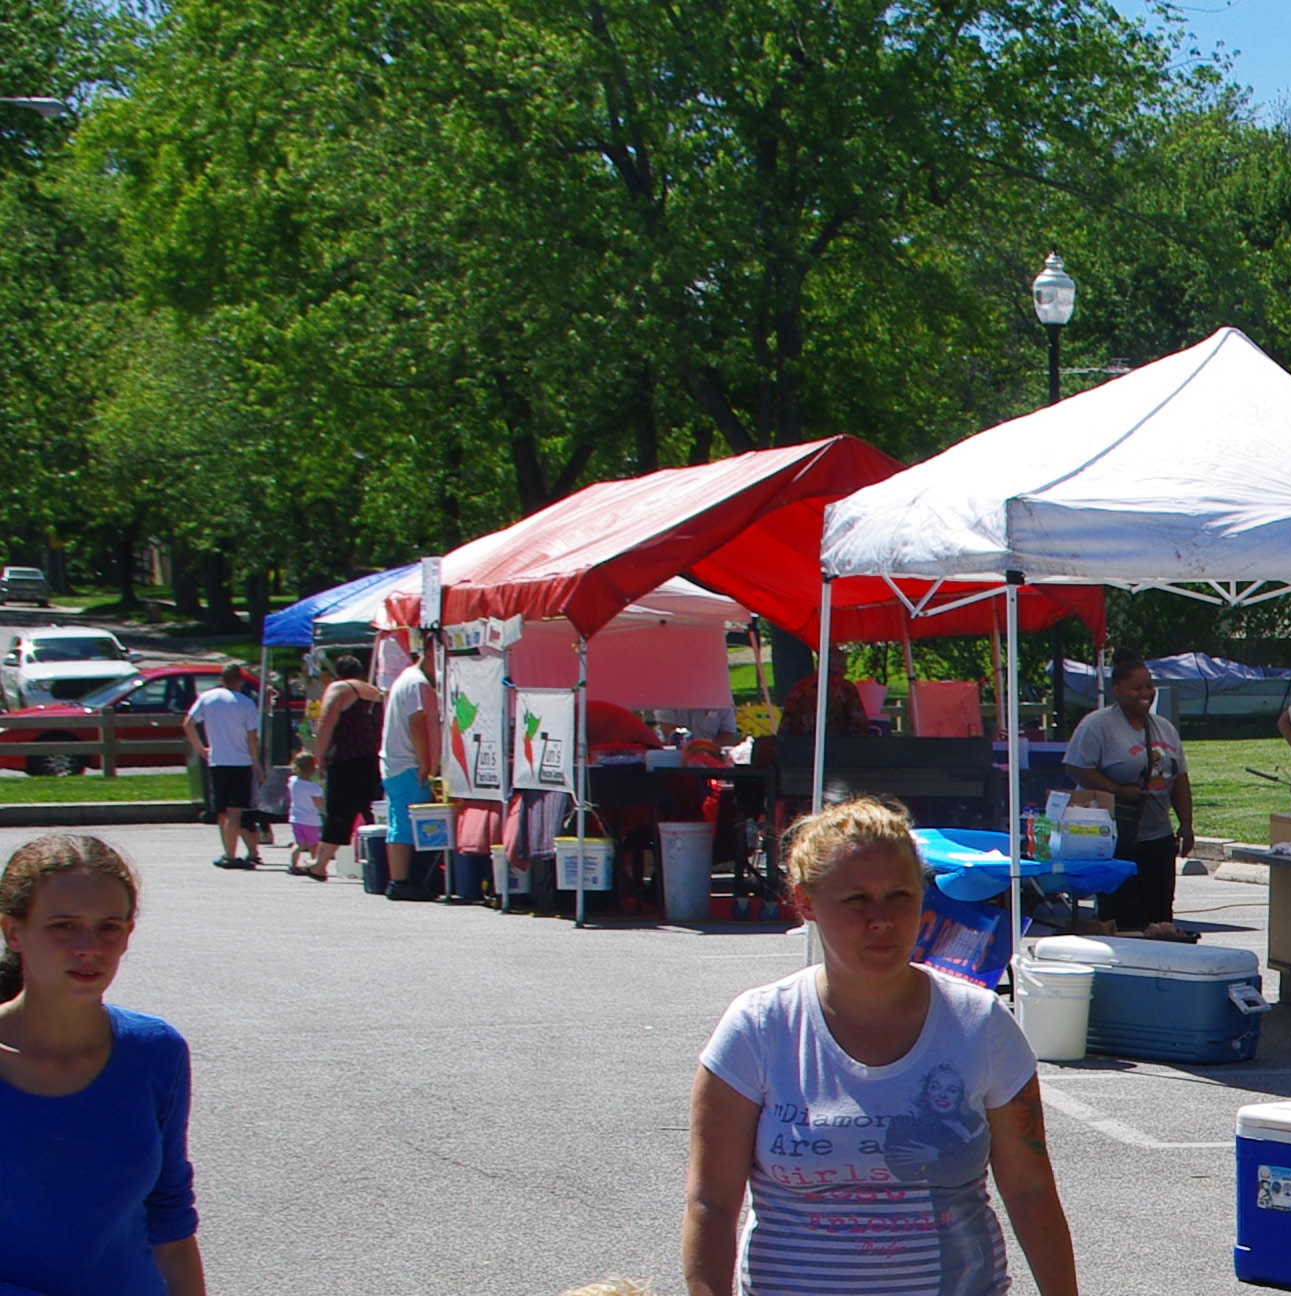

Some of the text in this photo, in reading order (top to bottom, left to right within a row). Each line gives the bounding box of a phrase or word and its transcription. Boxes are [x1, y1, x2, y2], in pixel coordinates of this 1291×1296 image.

[770, 1133, 886, 1157] Are a
[770, 1164, 891, 1185] Girls
